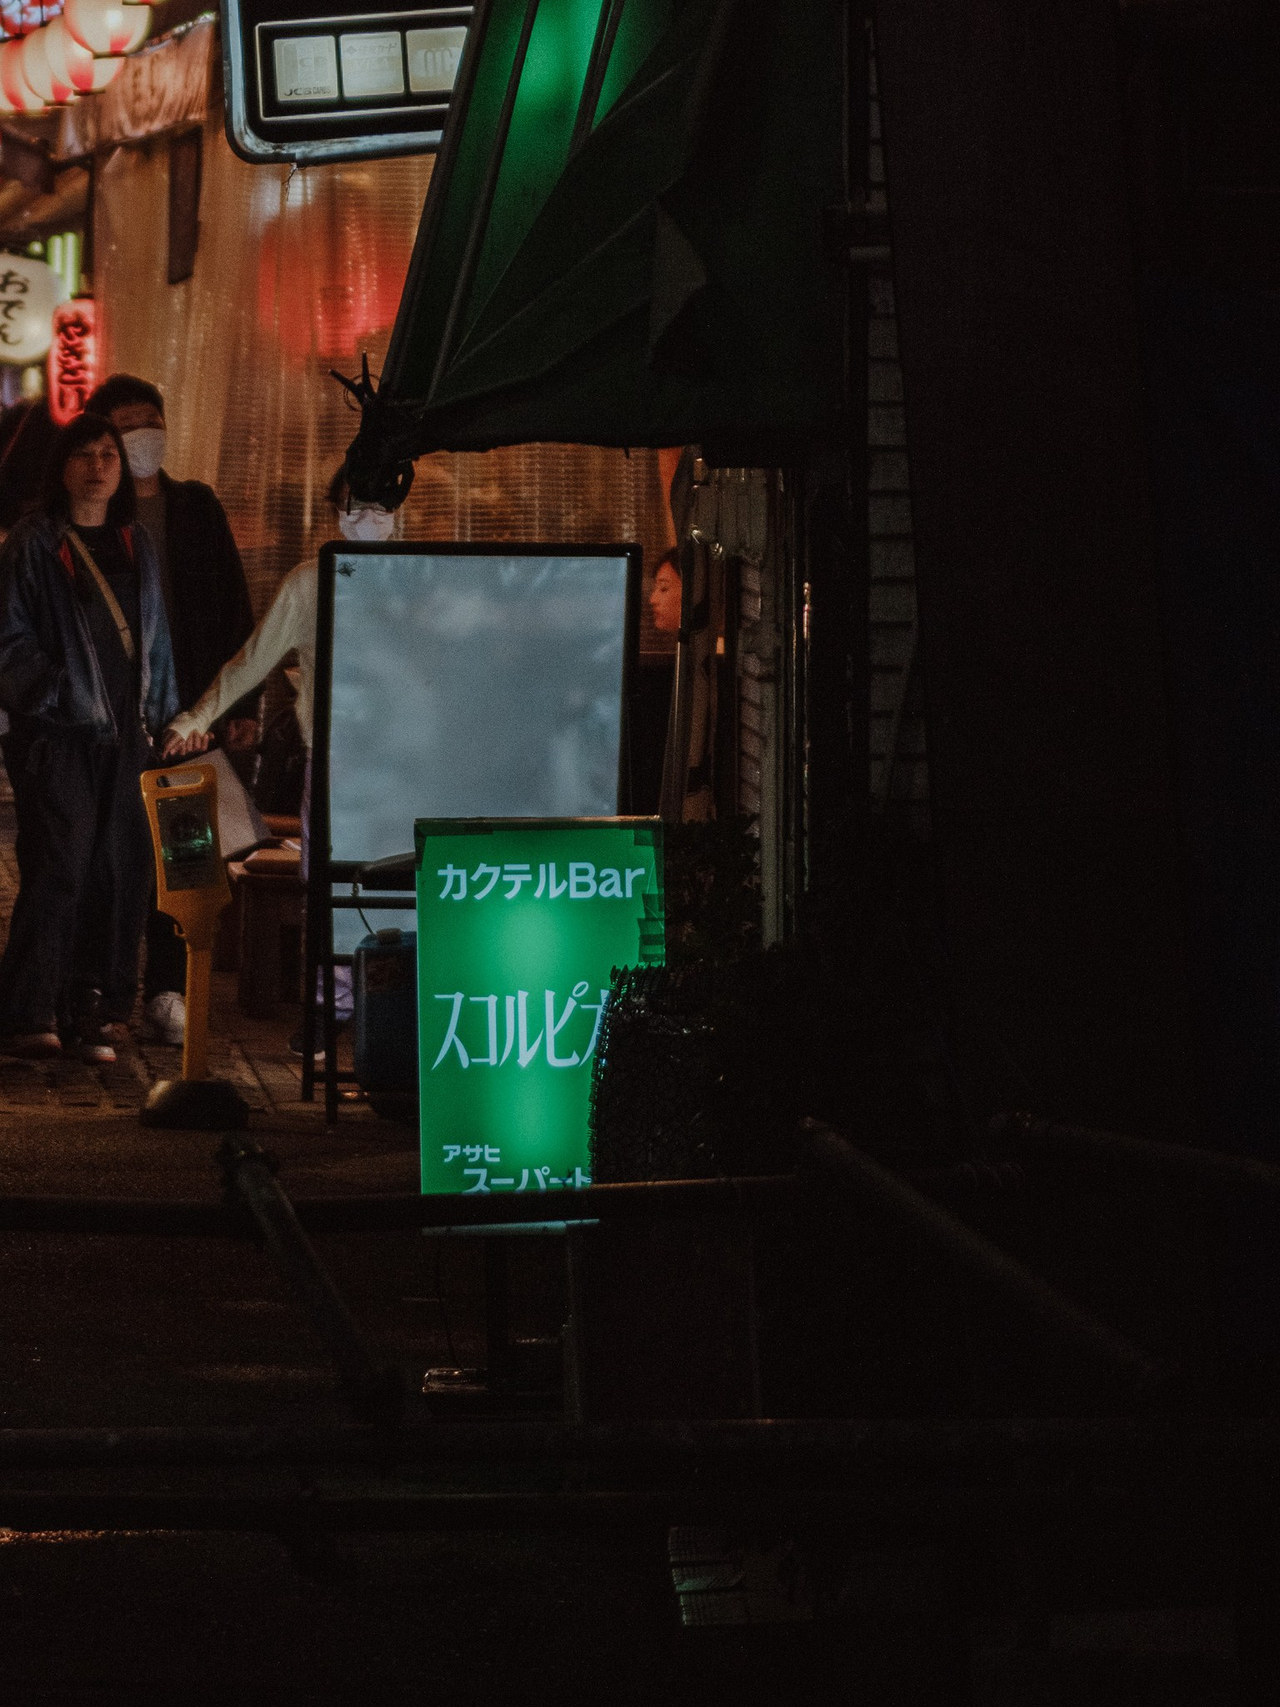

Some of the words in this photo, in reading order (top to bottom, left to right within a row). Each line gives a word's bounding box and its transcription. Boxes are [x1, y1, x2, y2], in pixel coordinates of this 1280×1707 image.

[437, 862, 645, 901] カクテルBar
[442, 1144, 501, 1163] アサヒ
